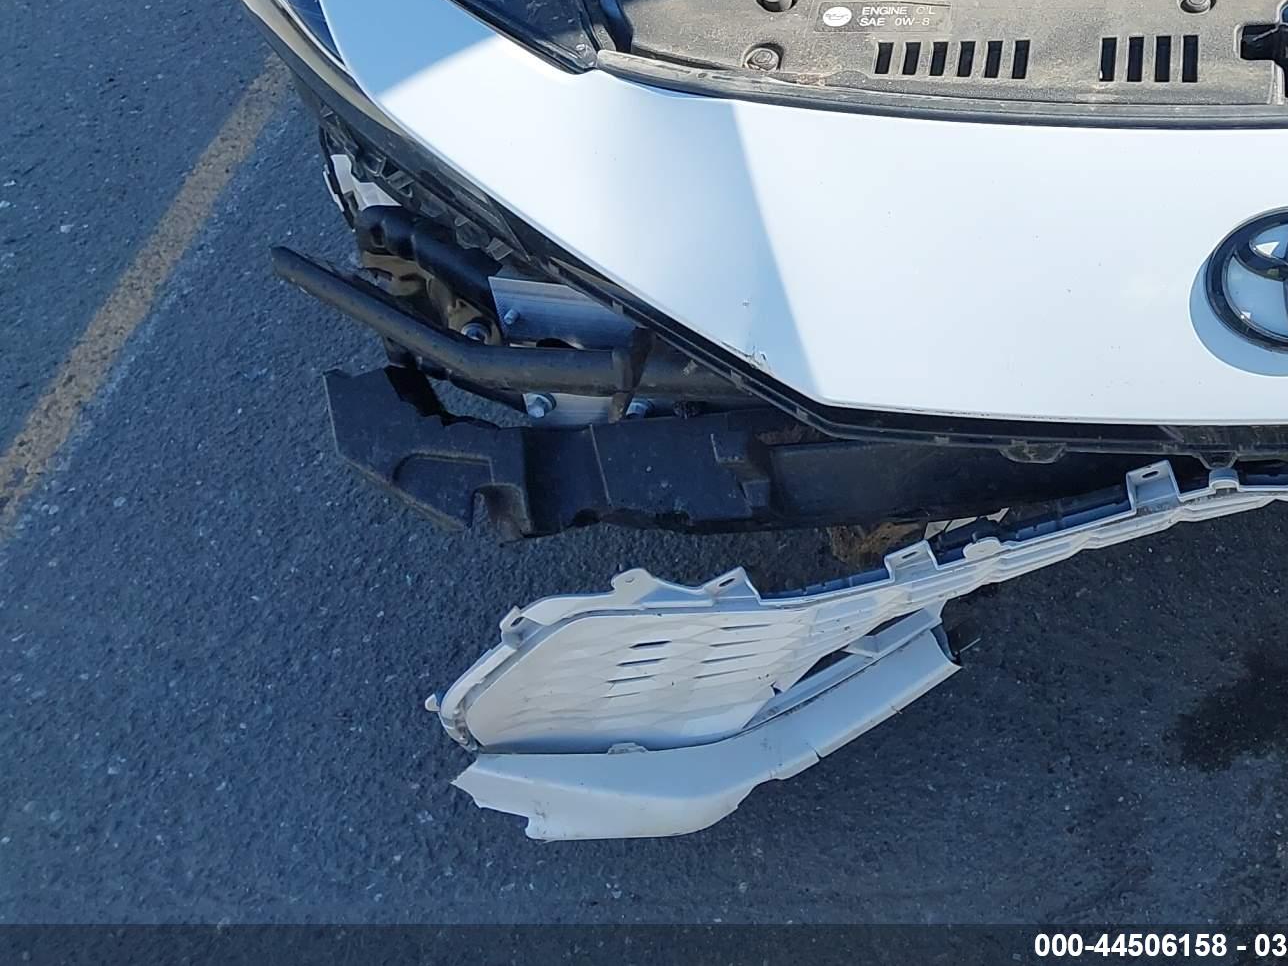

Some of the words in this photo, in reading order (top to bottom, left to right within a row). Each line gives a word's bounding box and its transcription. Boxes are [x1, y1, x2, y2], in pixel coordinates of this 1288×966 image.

[861, 6, 908, 16] ENGINE
[859, 17, 886, 27] SAE
[894, 17, 931, 26] 0W-8
